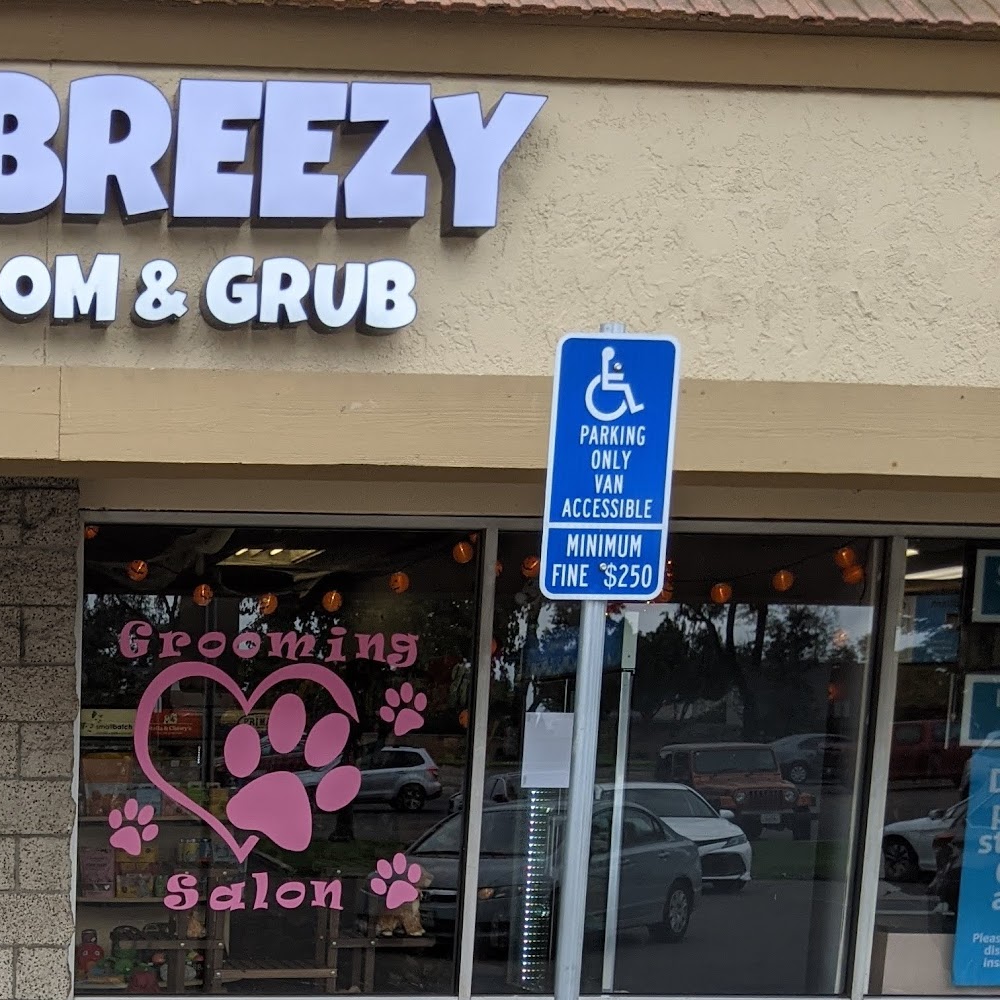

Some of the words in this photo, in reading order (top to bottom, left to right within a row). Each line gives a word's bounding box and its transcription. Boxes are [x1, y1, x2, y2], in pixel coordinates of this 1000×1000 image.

[133, 259, 188, 324] &
[206, 256, 418, 331] GRUB
[579, 424, 646, 446] PARKING
[591, 449, 632, 470] ONLY
[594, 474, 624, 494] VAN
[561, 498, 653, 519] ACCESSIBLE
[566, 533, 642, 558] MINIMUM
[552, 563, 589, 588] FINE
[603, 563, 653, 590] $250
[119, 620, 419, 668] Grooming
[163, 872, 344, 911] Salon
